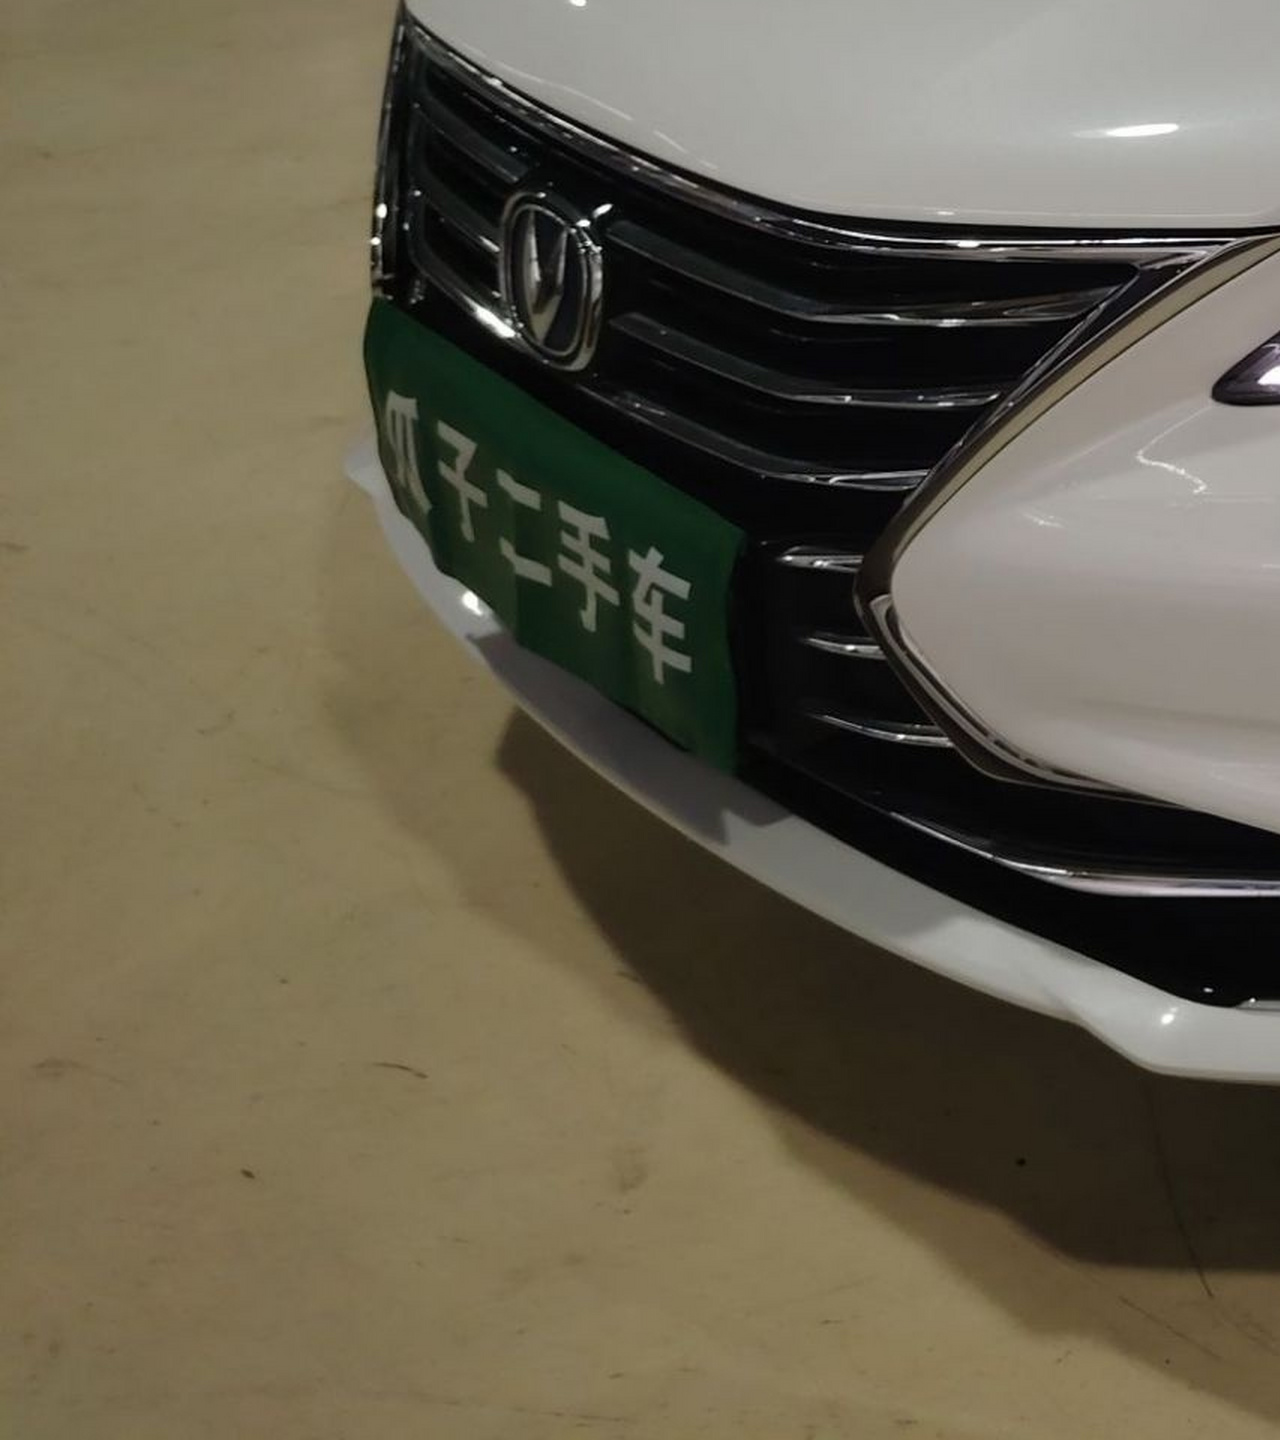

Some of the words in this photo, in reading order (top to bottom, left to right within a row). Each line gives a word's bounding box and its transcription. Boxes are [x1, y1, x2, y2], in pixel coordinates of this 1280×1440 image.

[386, 391, 692, 684] 瓜子二手车
